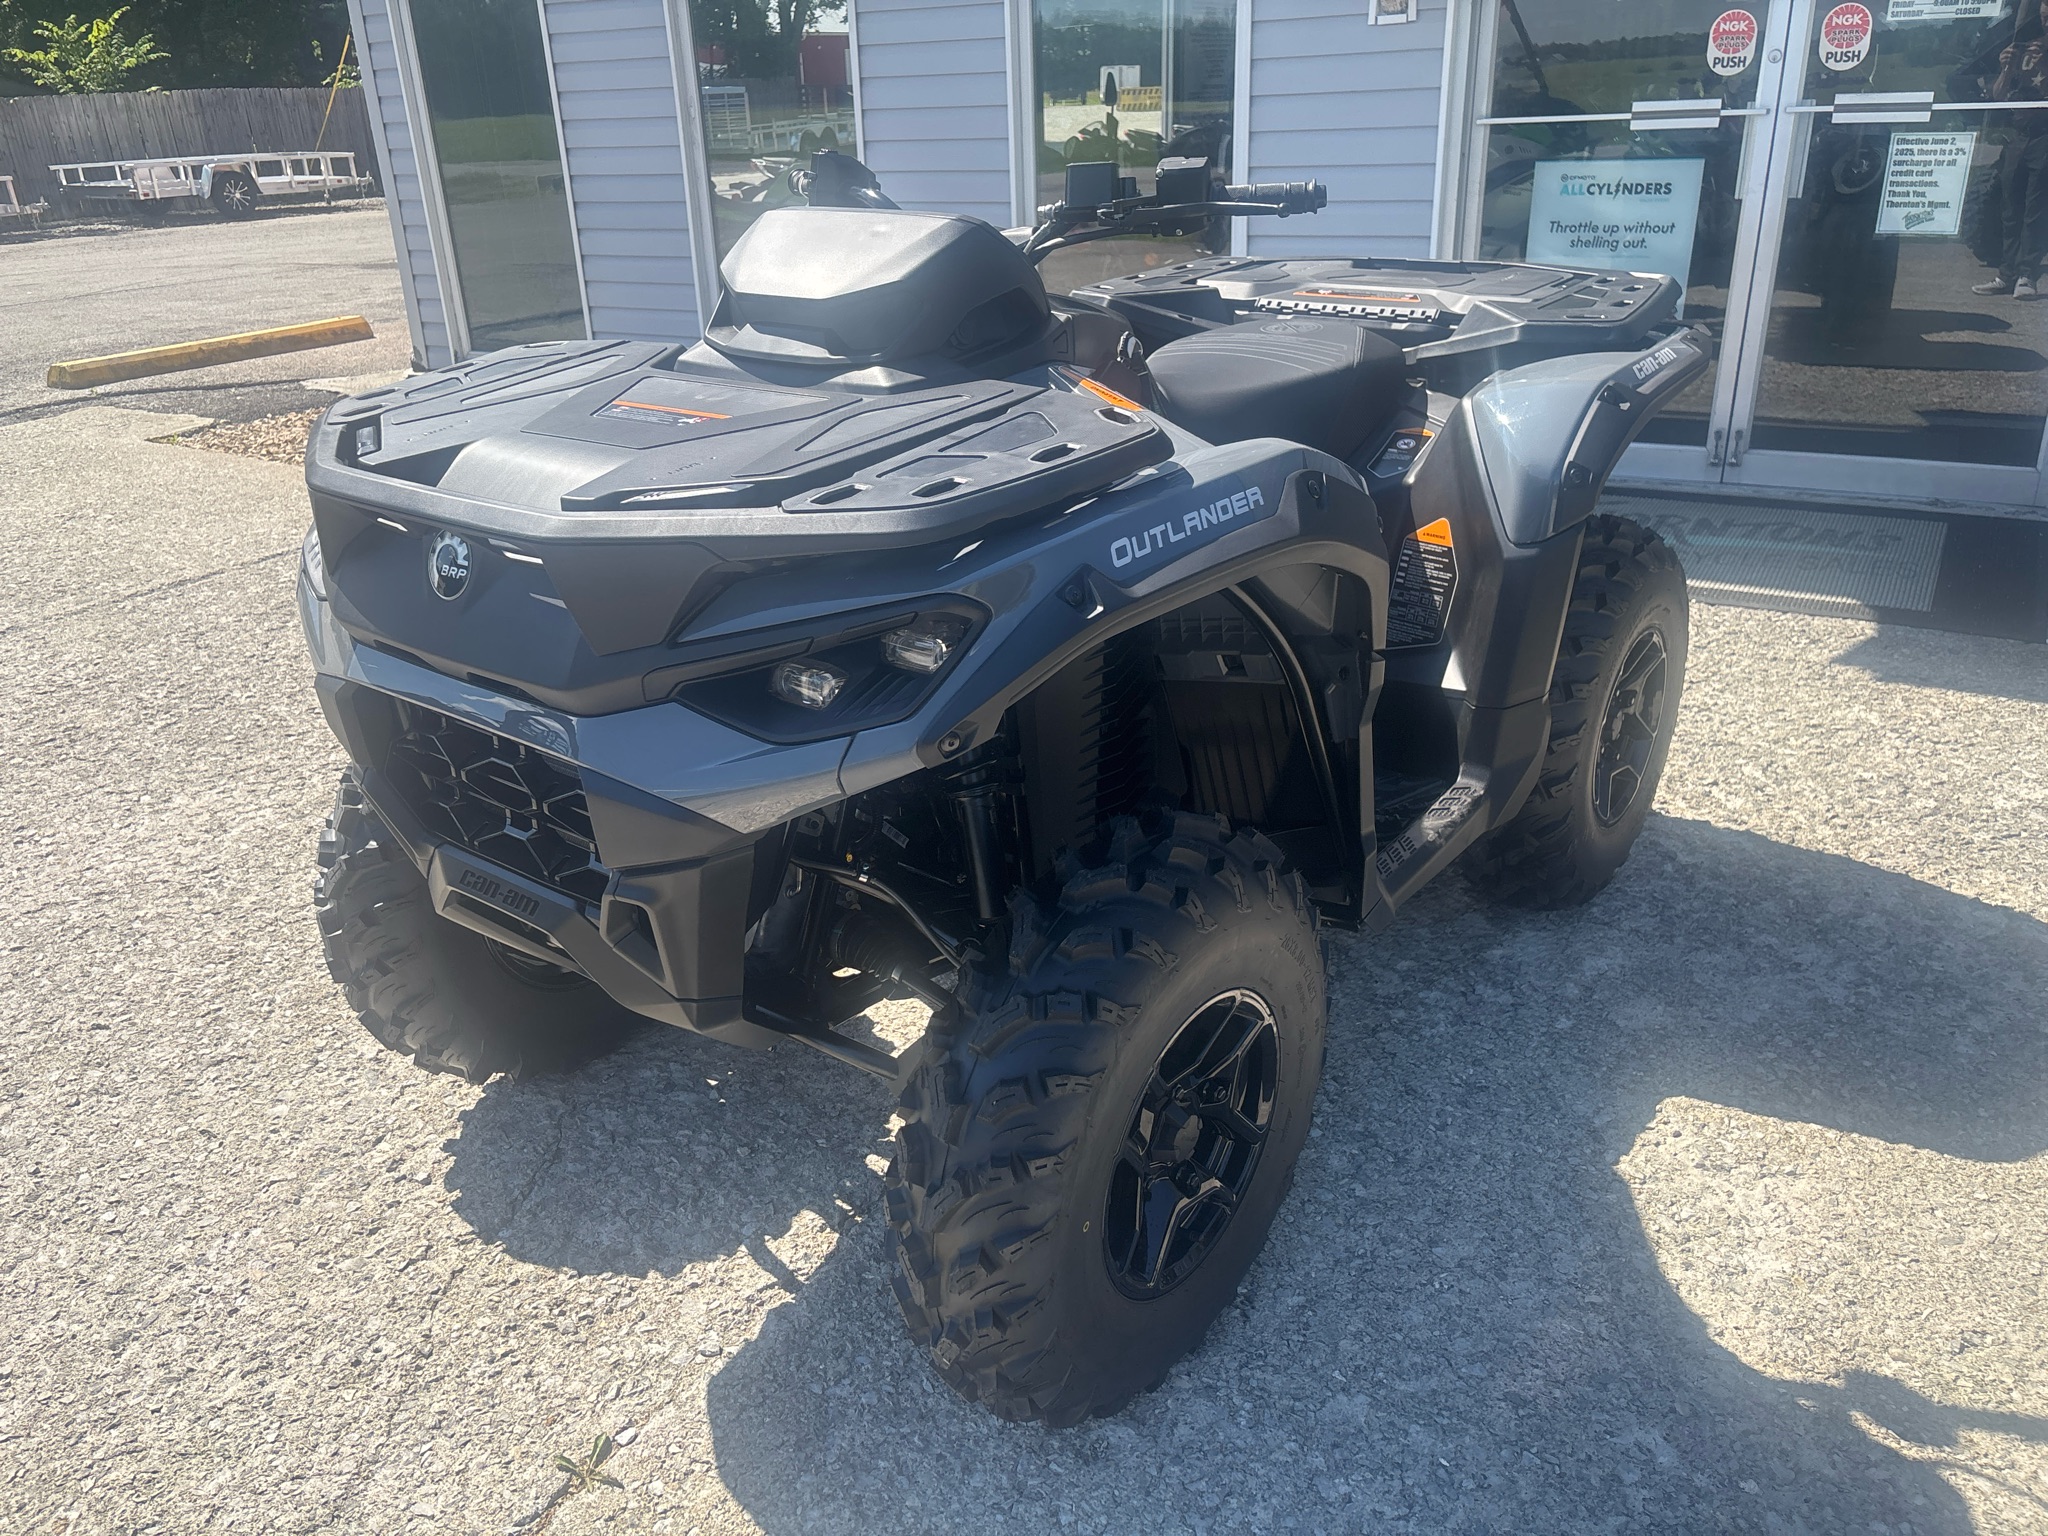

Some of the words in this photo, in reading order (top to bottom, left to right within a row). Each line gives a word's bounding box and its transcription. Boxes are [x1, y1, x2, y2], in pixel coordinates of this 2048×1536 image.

[1890, 10, 1924, 18] SATURDAY
[1832, 14, 1864, 26] NGK
[1719, 20, 1749, 32] NGK
[1830, 35, 1860, 43] PLUGS
[1718, 41, 1746, 49] PLUGS
[1825, 50, 1861, 63] PUSH
[1712, 56, 1747, 69] PUSH
[1896, 137, 1930, 145] Effective
[1930, 137, 1949, 146] June
[1950, 137, 1956, 146] 2,
[1894, 148, 1916, 156] 2025,
[1917, 148, 1938, 156] there
[1939, 148, 1946, 156] is
[1954, 148, 1966, 156] 3%
[1892, 159, 1932, 167] surcharge
[1890, 169, 1914, 177] credit
[1889, 180, 1940, 188] transactions.
[1888, 190, 1910, 198] Thank
[1912, 190, 1928, 198] You,
[1886, 200, 1926, 208] Thornton's
[1927, 200, 1951, 209] Mgmt.
[1550, 221, 1599, 234] Throttle
[1602, 224, 1620, 237] up
[1624, 222, 1676, 234] without
[1569, 236, 1620, 252] shelling
[1622, 238, 1648, 249] out.
[1632, 347, 1677, 380] can-am
[1110, 486, 1264, 568] OUTLANDER
[440, 564, 467, 579] BRP
[459, 869, 540, 917] can-am
